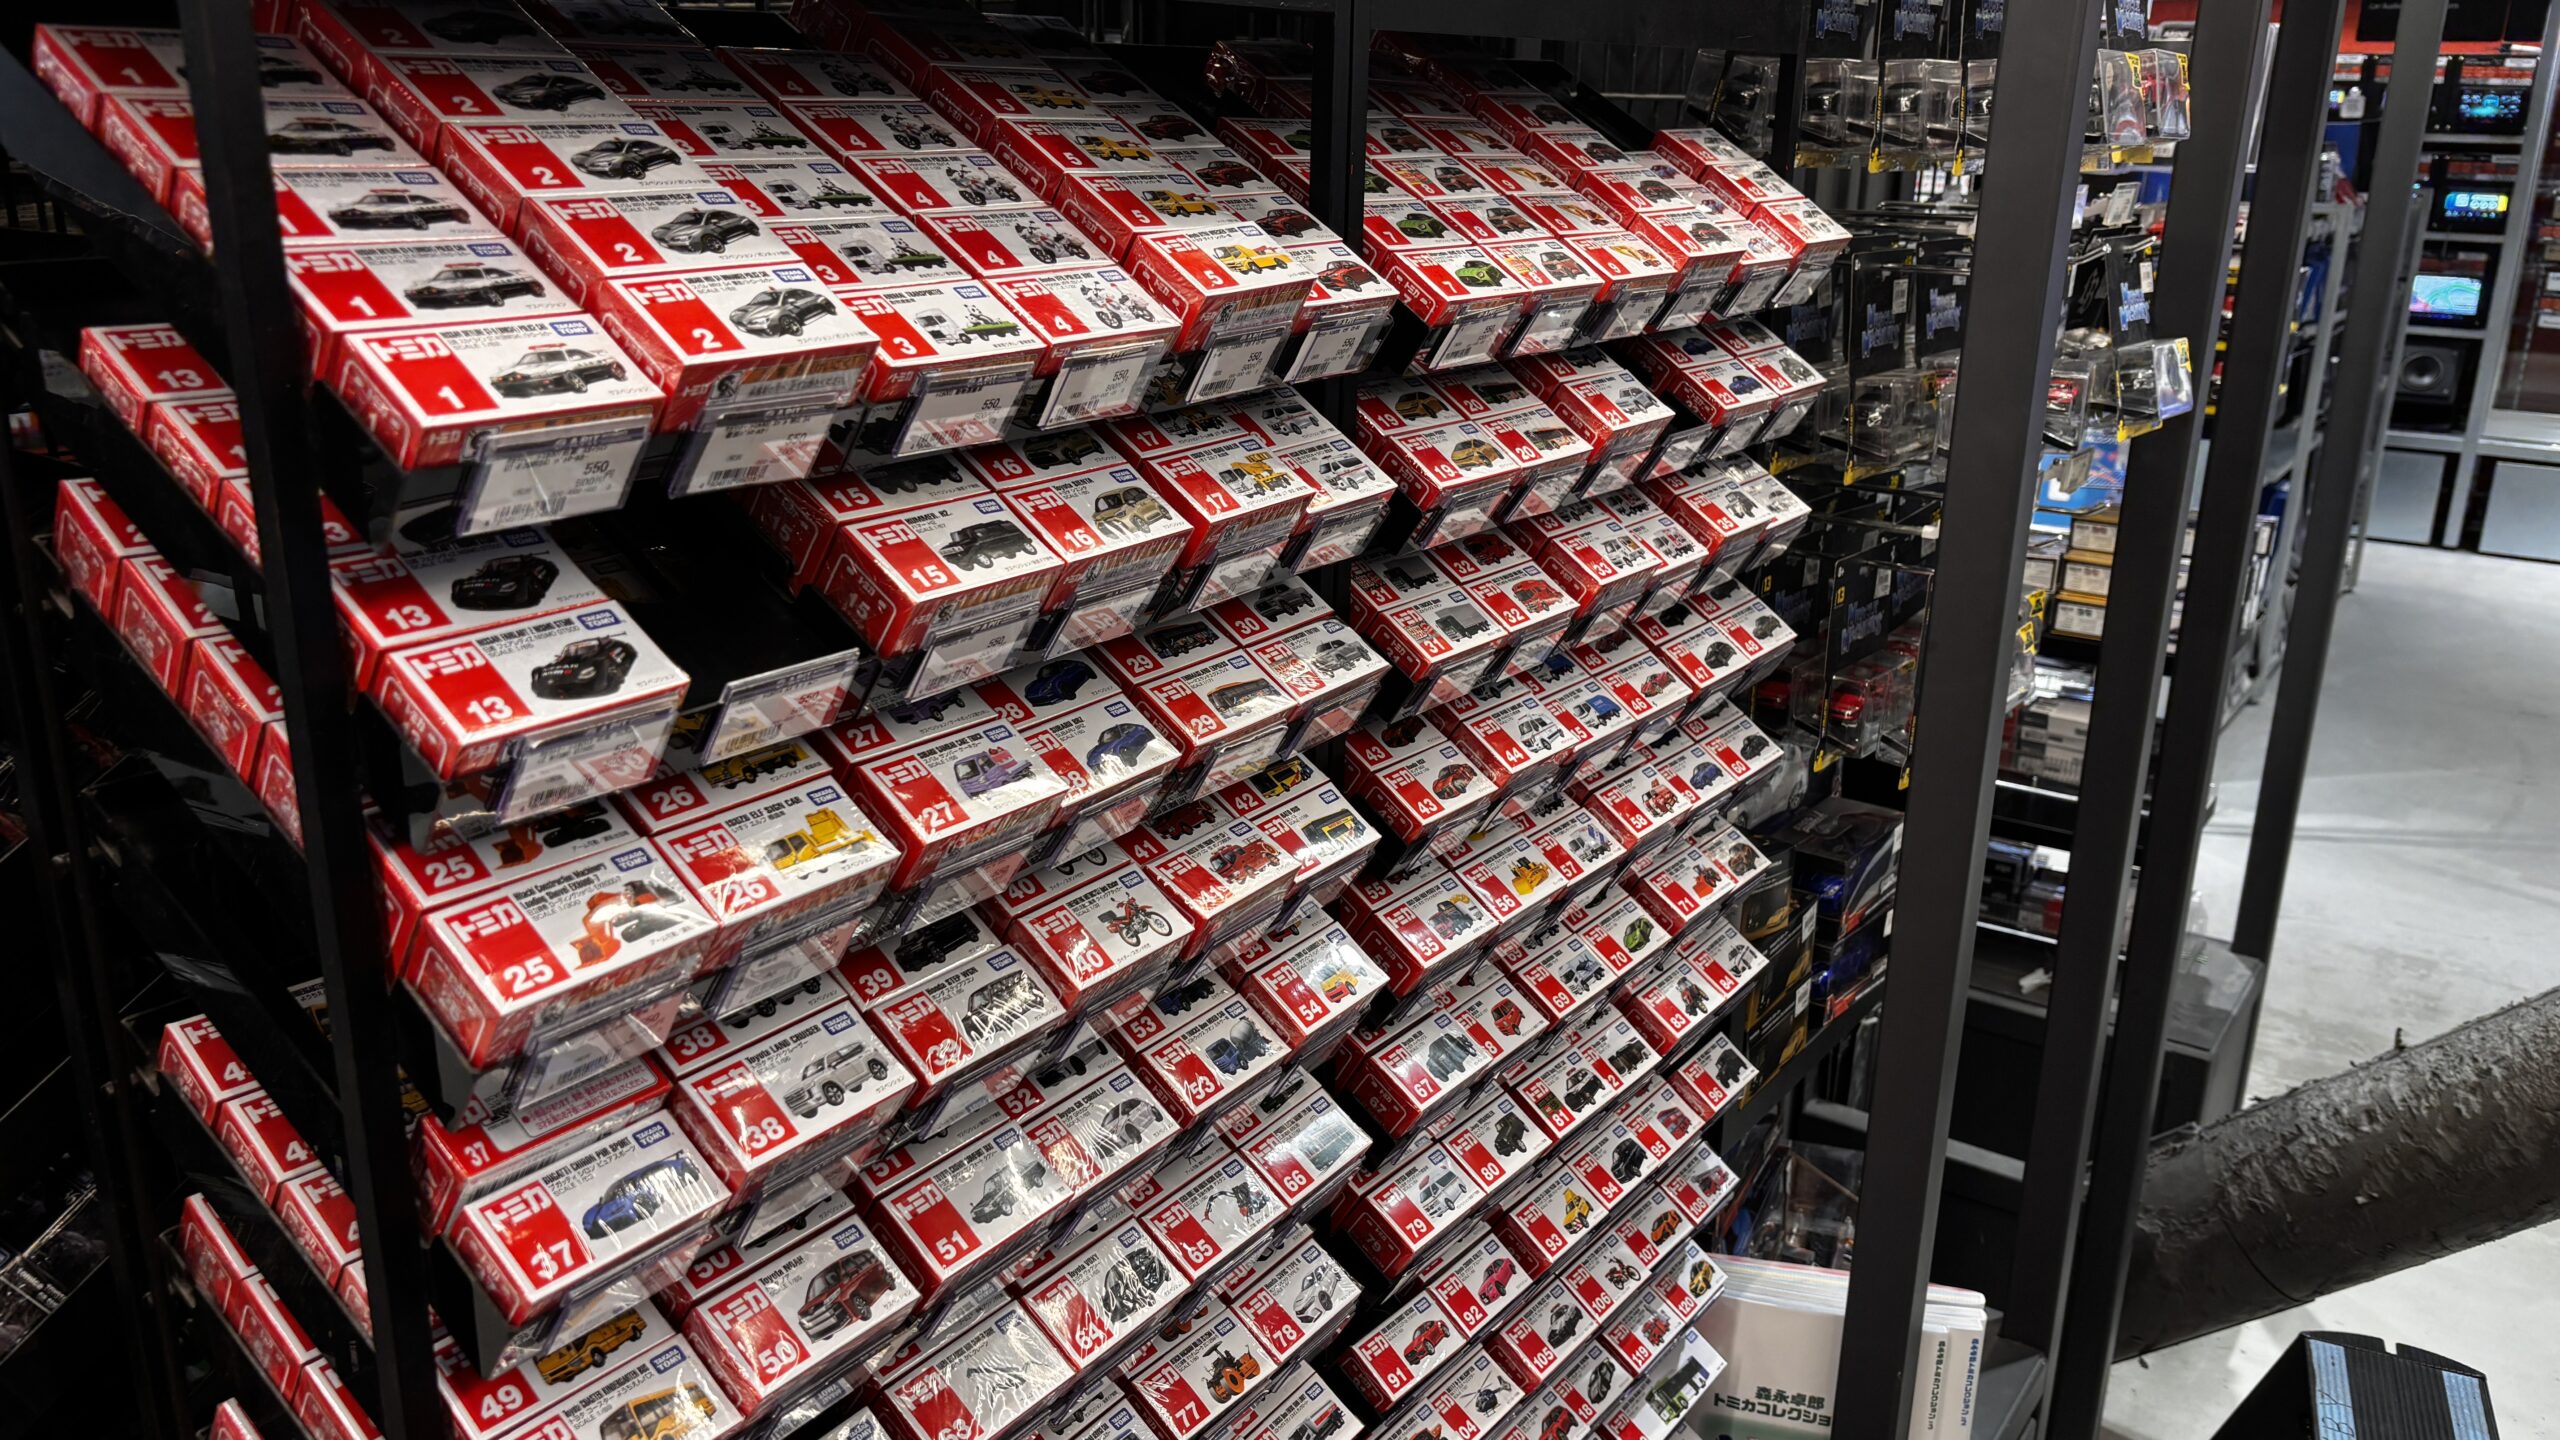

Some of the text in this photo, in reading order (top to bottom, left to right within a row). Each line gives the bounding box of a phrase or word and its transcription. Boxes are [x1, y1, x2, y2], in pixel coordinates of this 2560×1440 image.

[452, 96, 481, 112] 2
[849, 134, 867, 149] 4
[1062, 151, 1083, 166] 5
[531, 166, 562, 186] 2
[1501, 179, 1516, 192] 9
[915, 192, 934, 206] 4
[1130, 209, 1151, 225] 5
[1554, 219, 1570, 230] 9
[614, 242, 644, 263] 2
[1154, 236, 1197, 253] トミカ
[987, 250, 1006, 266] 4
[817, 265, 841, 282] 3
[1607, 262, 1622, 274] 9
[1203, 271, 1224, 287] 5
[628, 282, 697, 305] トミカ
[1000, 280, 1050, 300] トミカ
[350, 296, 377, 317] 1
[560, 326, 589, 335] TOMY
[1055, 315, 1074, 332] 4
[107, 330, 187, 350] トミカ
[692, 328, 724, 350] 2
[892, 337, 918, 355] 3
[367, 337, 452, 362] トミカ
[157, 368, 204, 389] 13
[1112, 369, 1129, 382] 550
[438, 386, 465, 409] 1
[981, 398, 1001, 411] 550
[1136, 431, 1158, 447] 17
[1515, 445, 1536, 460] 20
[583, 461, 610, 476] 550
[991, 459, 1024, 477] 16
[1114, 473, 1136, 482] TOMY
[833, 485, 871, 507] 15
[1017, 489, 1065, 513] トミカ
[1204, 492, 1229, 512] 17
[980, 506, 1002, 514] TOMY
[863, 525, 917, 548] トミカ
[1064, 529, 1093, 550] 16
[911, 565, 948, 588] 15
[1454, 560, 1474, 574] 32
[1593, 563, 1613, 577] 33
[1371, 588, 1393, 601] 31
[385, 604, 432, 630] 13
[585, 617, 616, 628] TOMY
[1235, 617, 1261, 635] 30
[1504, 610, 1524, 624] 32
[411, 644, 488, 679] トミカ
[1126, 655, 1155, 674] 29
[1153, 683, 1196, 703] トミカ
[466, 696, 514, 723] 13
[1072, 716, 1085, 725] BRZ
[846, 726, 883, 748] 27
[1365, 747, 1386, 761] 43
[1505, 748, 1526, 763] 44
[875, 760, 929, 787] トミカ
[1386, 770, 1416, 788] トミカ
[651, 785, 697, 814] 26
[815, 793, 837, 803] TOMY
[1235, 792, 1259, 810] 42
[1417, 800, 1438, 814] 43
[725, 813, 750, 828] ISUZU
[749, 809, 764, 820] ELF
[763, 803, 786, 814] SIGN
[784, 796, 802, 807] CAR
[673, 830, 738, 863] トミカ
[1134, 840, 1151, 859] 41
[424, 855, 476, 888] 25
[621, 858, 648, 869] TOMY
[1159, 855, 1197, 879] トミカ
[1561, 862, 1579, 876] 57
[1494, 896, 1516, 911] 56
[451, 906, 524, 943] トミカ
[1416, 937, 1440, 956] 55
[993, 959, 1019, 971] TOMY
[502, 956, 555, 994] 25
[859, 970, 894, 996] 39
[1552, 992, 1570, 1006] 69
[1229, 1006, 1244, 1017] TOMY
[1298, 999, 1324, 1022] 54
[828, 1019, 851, 1032] TOMY
[1131, 1015, 1158, 1040] 53
[1670, 1015, 1687, 1030] 83
[675, 1024, 717, 1054] 38
[745, 1025, 822, 1064] Toyota LAND CRUISER
[1412, 1082, 1436, 1098] 67
[1004, 1086, 1041, 1114] 52
[636, 1125, 662, 1138] TAKARA
[640, 1130, 666, 1145] TOMY
[463, 1141, 492, 1167] 37
[541, 1137, 632, 1186] BUGATTI CHIRON PUR SPORT
[1282, 1170, 1308, 1192] 66
[1481, 1162, 1501, 1182] 80
[894, 1182, 945, 1218] トミカ
[1602, 1183, 1620, 1199] 94
[484, 1186, 554, 1232] トミカ
[1153, 1205, 1189, 1232] トミカ
[1405, 1218, 1428, 1238] 79
[837, 1231, 865, 1249] TOMY
[935, 1229, 969, 1262] 51
[1544, 1234, 1563, 1250] 93
[1067, 1253, 1100, 1279] Toyota VOXY
[759, 1267, 784, 1287] Toyota
[713, 1287, 772, 1331] トミカ
[1462, 1306, 1483, 1325] 92
[1273, 1323, 1298, 1348] 78
[654, 1349, 680, 1365] TAKARA
[1361, 1335, 1389, 1360] トミカ
[657, 1355, 682, 1371] TOMY
[1386, 1368, 1410, 1388] 91
[478, 1384, 524, 1421] 49
[1755, 1386, 1826, 1410] 森永卓郎
[1174, 1400, 1202, 1426] 77
